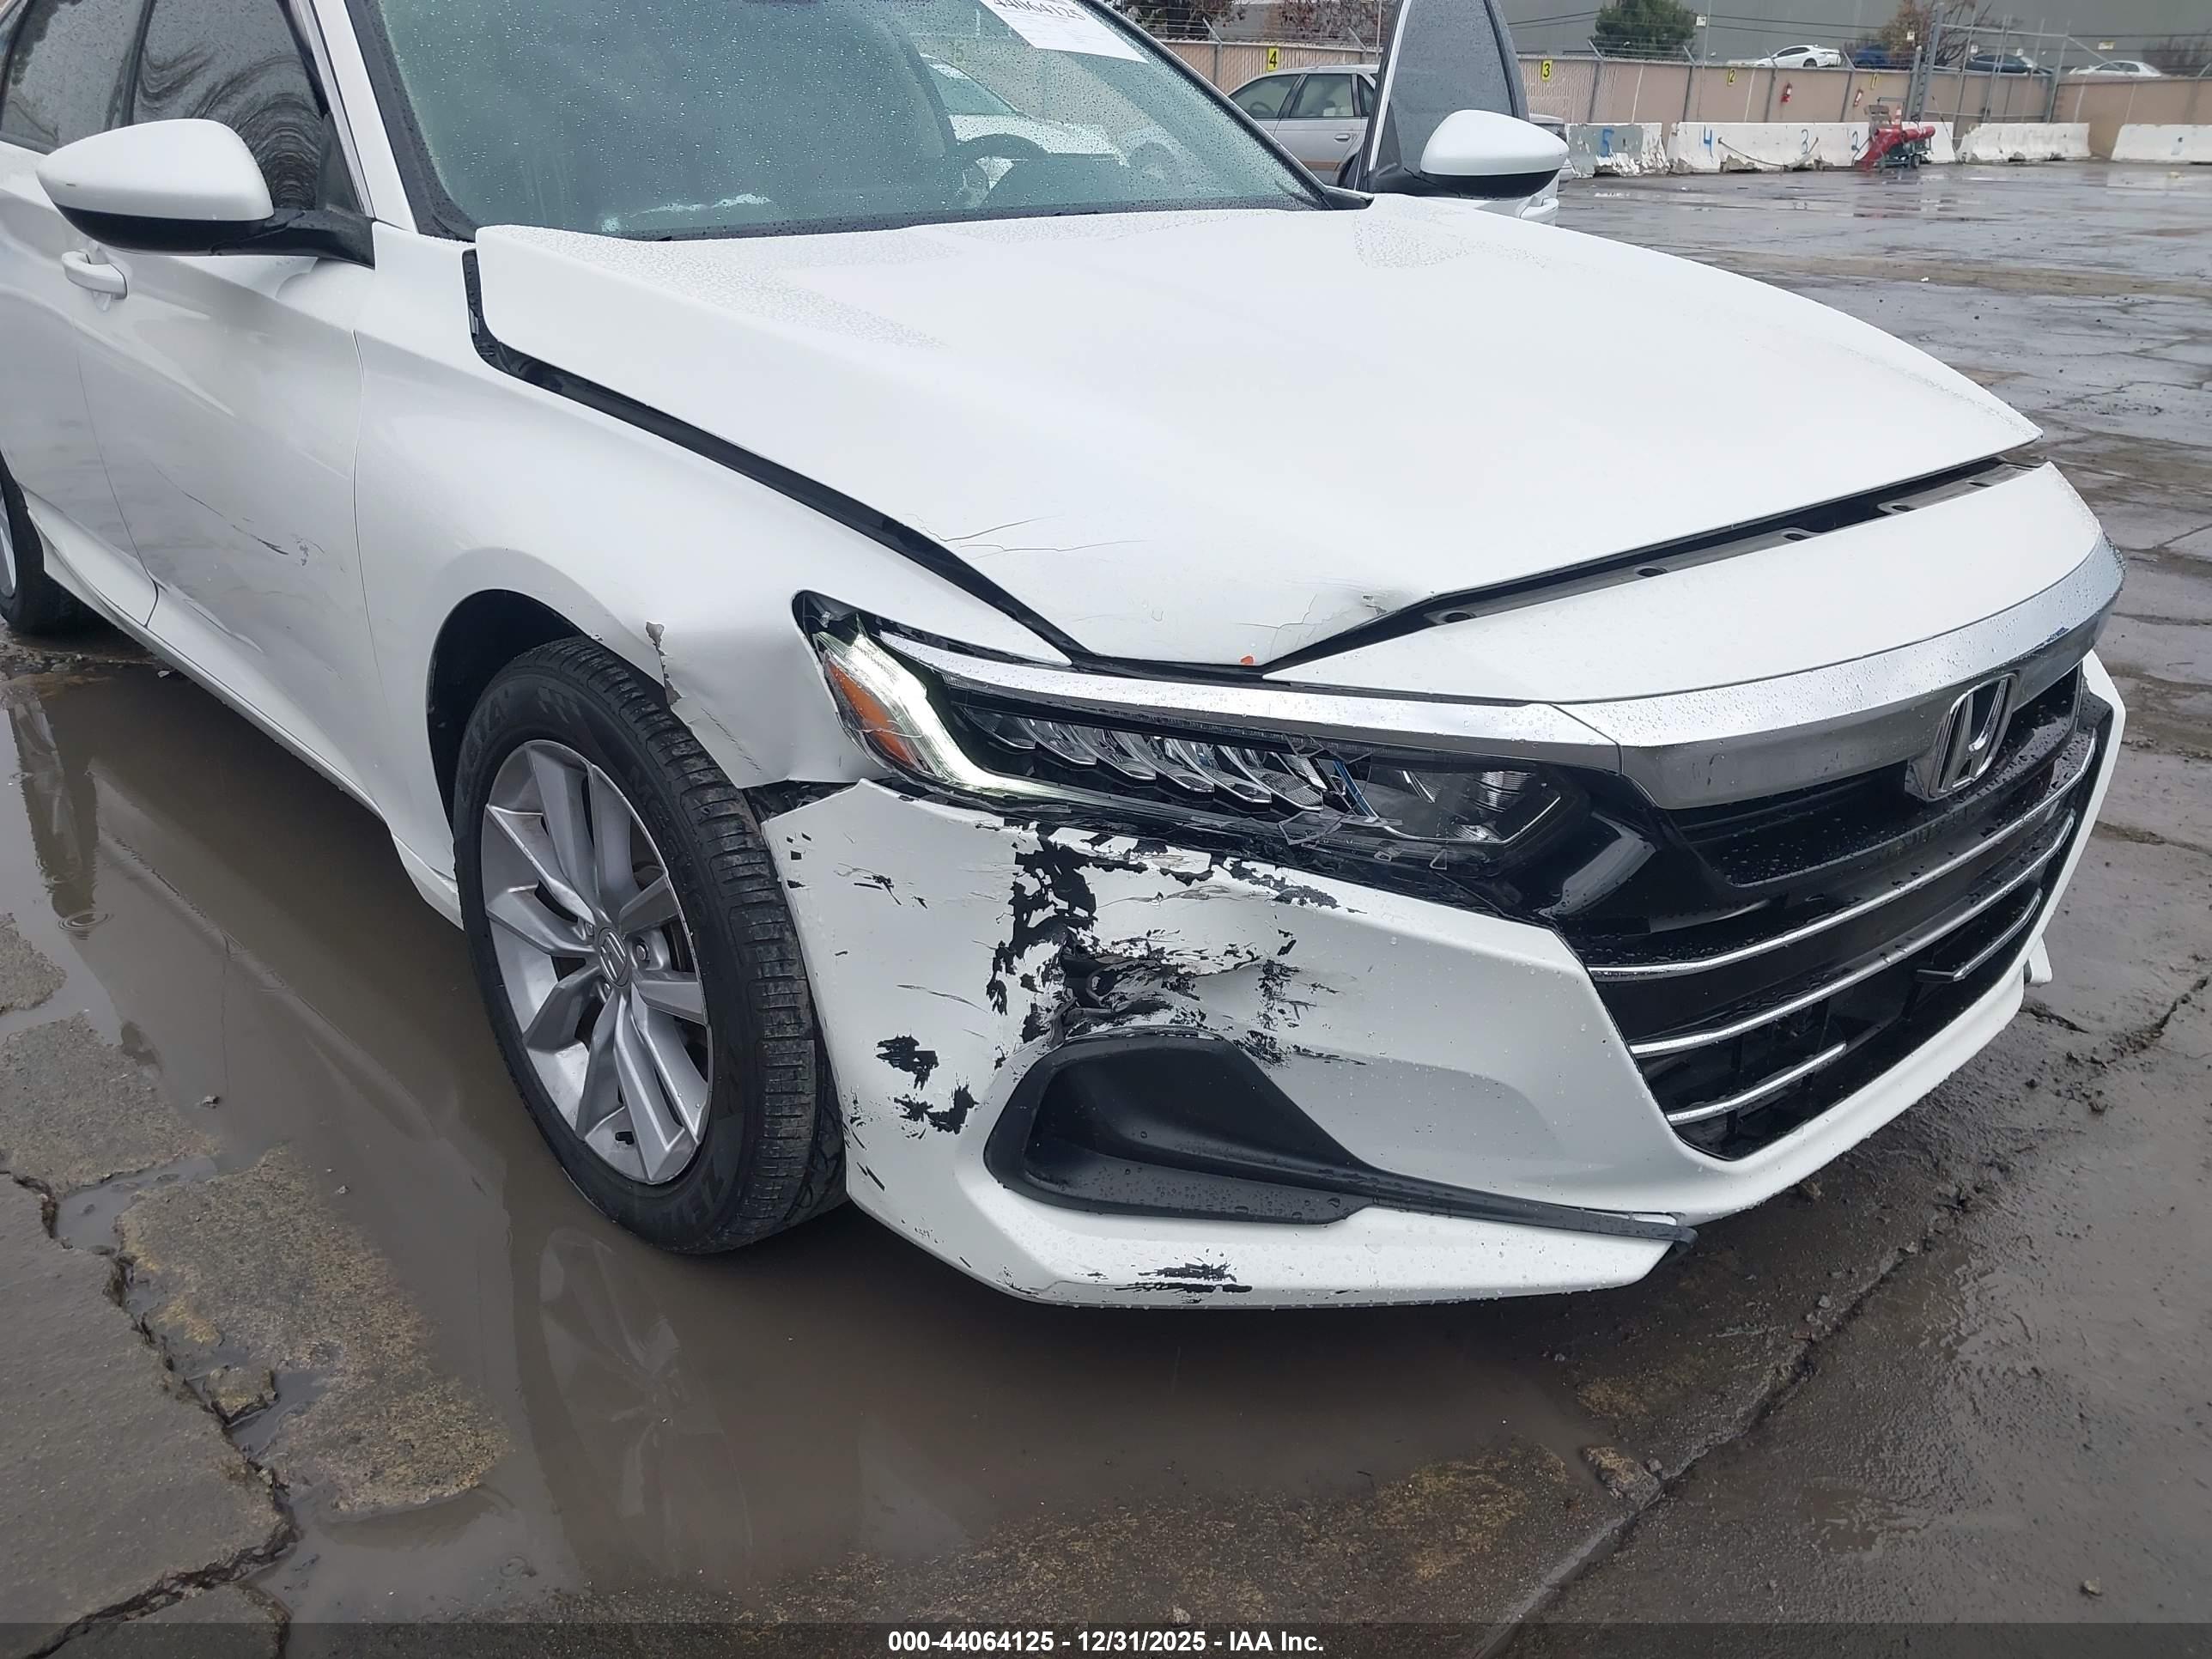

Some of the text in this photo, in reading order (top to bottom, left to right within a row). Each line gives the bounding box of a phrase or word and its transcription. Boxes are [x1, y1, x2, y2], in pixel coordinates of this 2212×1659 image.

[1269, 51, 1278, 68] 4
[1543, 63, 1550, 77] 3
[1729, 70, 1735, 83] 2
[1601, 129, 1614, 158] 5
[1704, 125, 1713, 156] 4
[1801, 129, 1809, 155] 3
